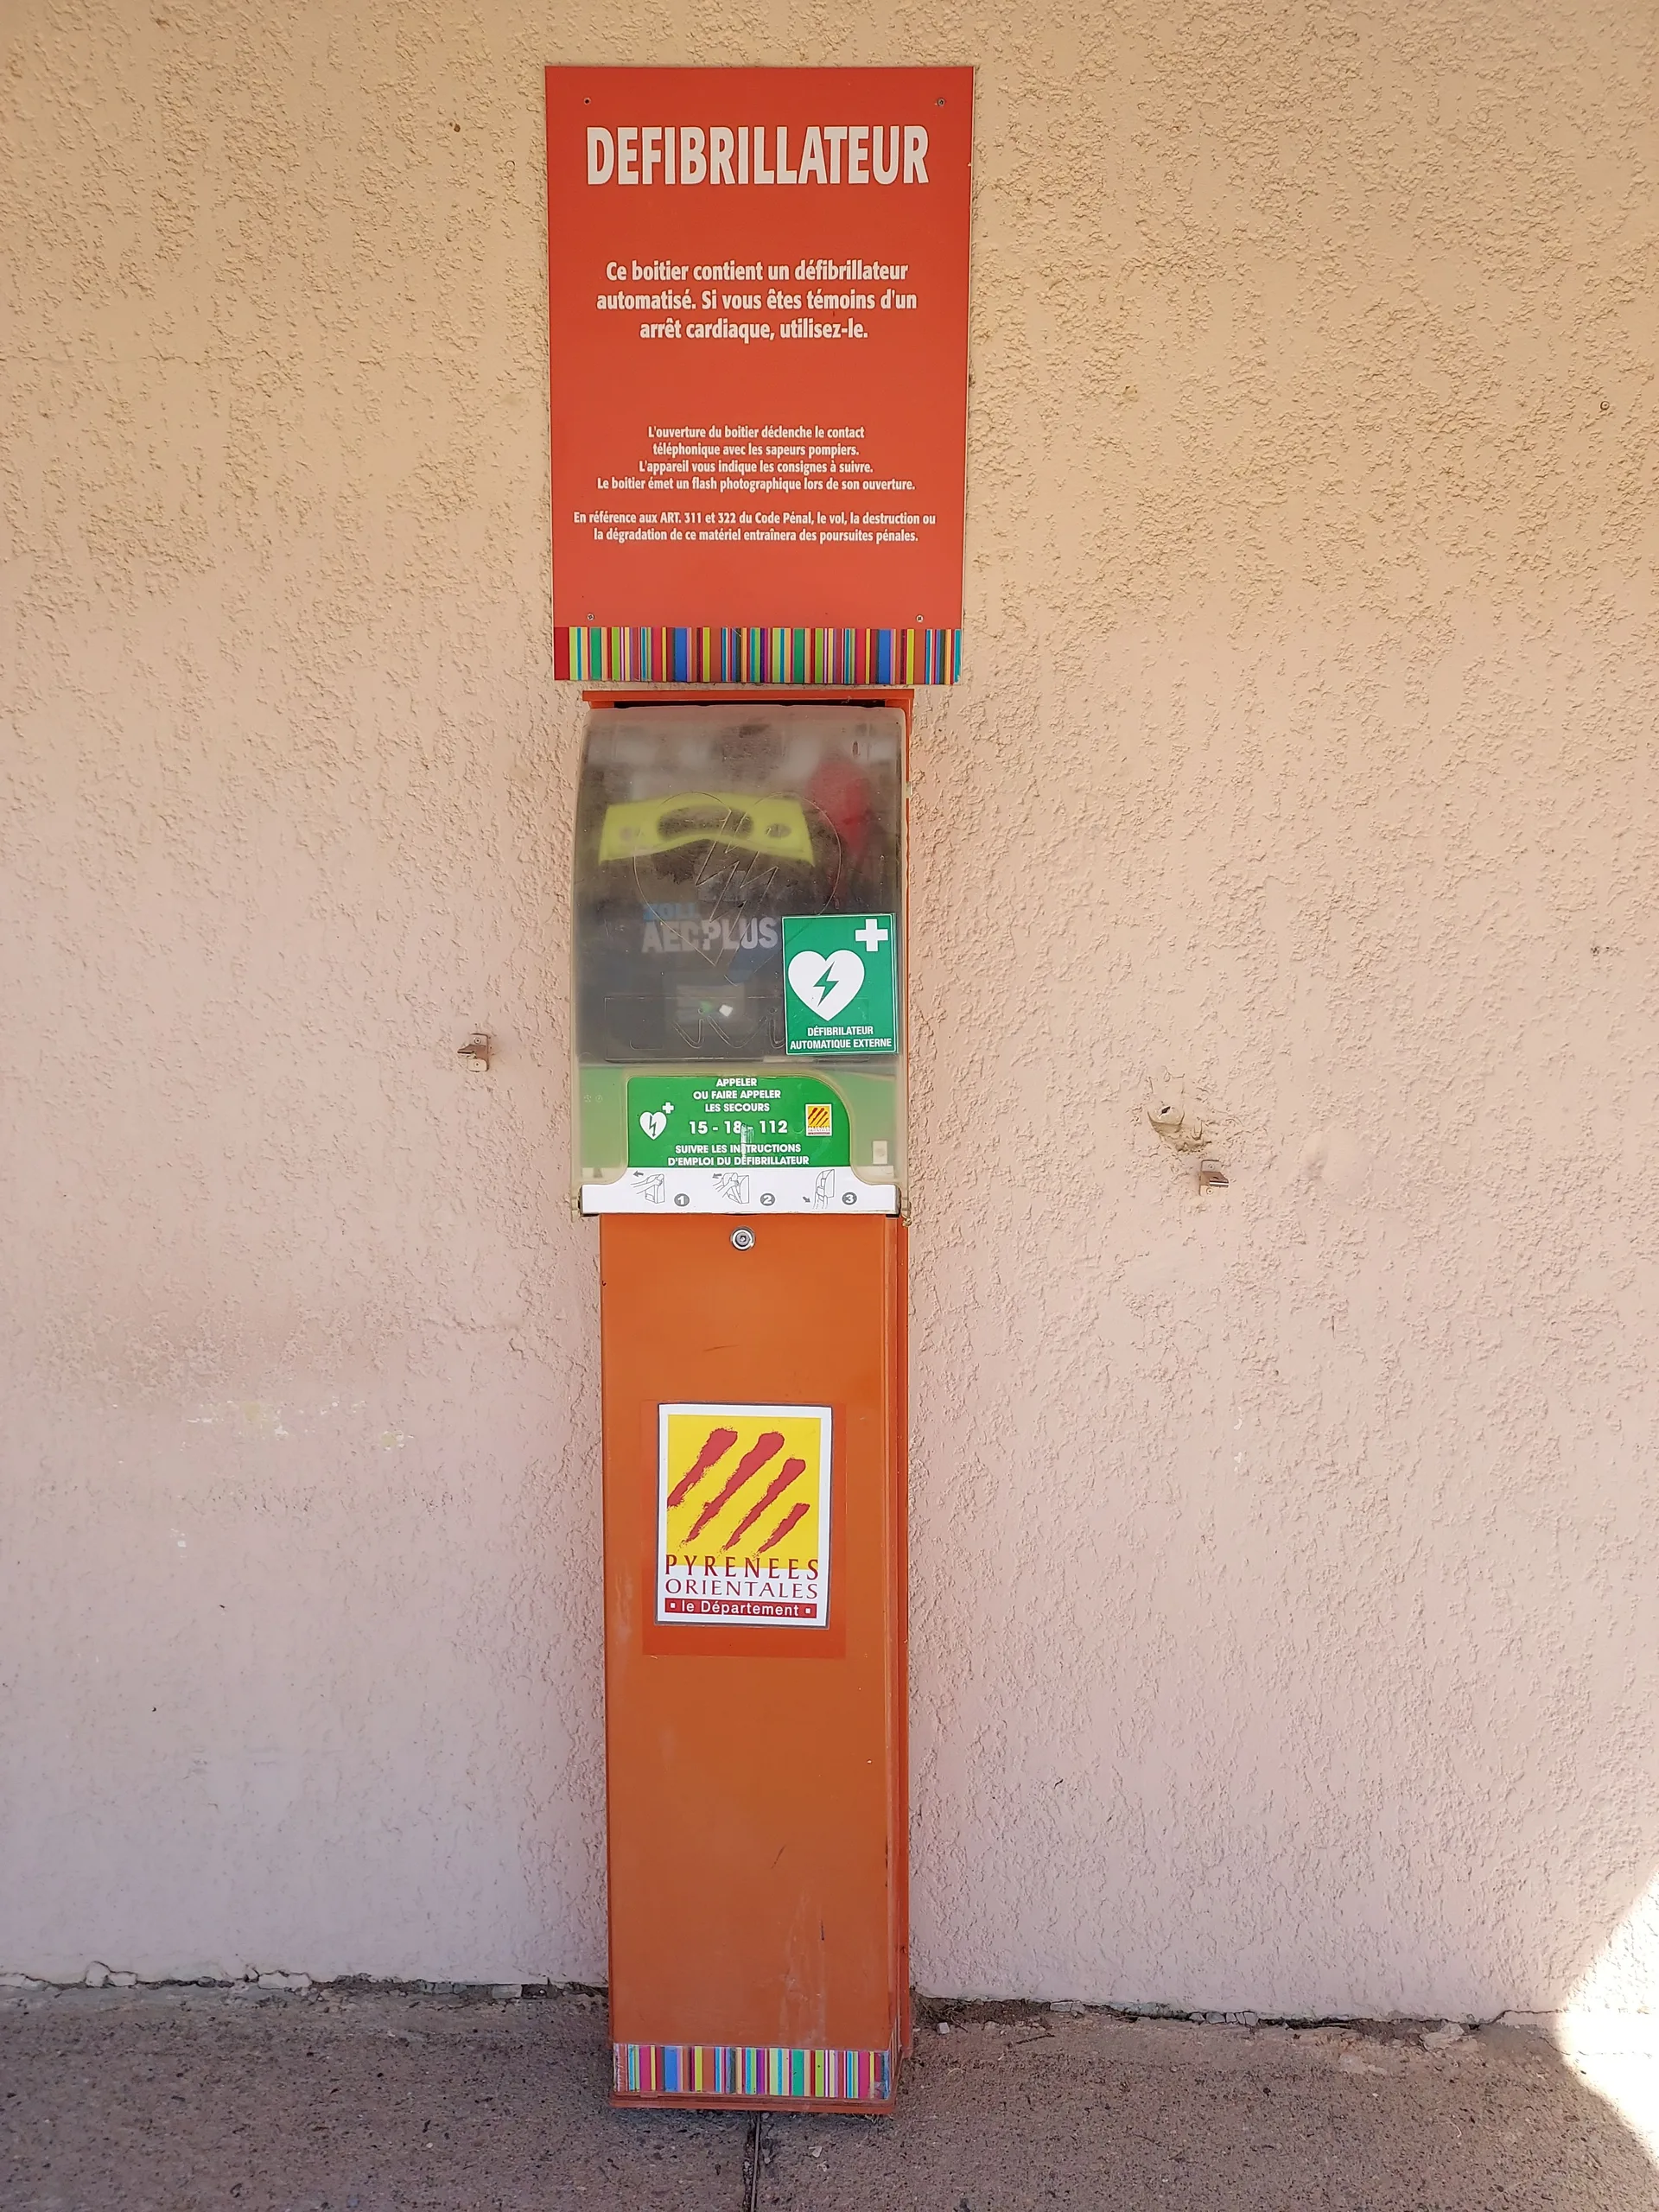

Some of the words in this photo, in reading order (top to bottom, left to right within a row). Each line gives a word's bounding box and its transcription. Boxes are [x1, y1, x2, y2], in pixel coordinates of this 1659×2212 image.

[587, 125, 929, 185] DEFIBRILLATEUR
[606, 261, 627, 281] Ce
[632, 259, 690, 281] boitier
[693, 259, 764, 281] contient
[767, 265, 790, 281] un
[794, 258, 909, 281] défibrillateur
[596, 289, 696, 310] automatisé.
[702, 289, 717, 310] Si
[721, 294, 762, 310] vous
[766, 288, 803, 310] êtes
[806, 288, 875, 309] témoins
[880, 288, 917, 309] d'un
[639, 317, 682, 339] arrêt
[685, 317, 775, 345] cardiaque,
[779, 317, 868, 339] utilisez-le.
[648, 425, 707, 438] L'ouverture
[708, 424, 722, 438] du
[724, 425, 760, 438] boitier
[760, 424, 813, 439] déclenche
[814, 425, 825, 439] le
[826, 426, 865, 439] contact
[652, 442, 721, 459] téléphonique
[722, 445, 747, 455] avec
[747, 442, 763, 455] les
[765, 446, 806, 459] sapeurs
[808, 442, 860, 460] pompiers.
[639, 459, 690, 476] L'appareil
[691, 462, 716, 473] vous
[718, 459, 758, 476] indique
[760, 459, 775, 473] les
[777, 460, 828, 476] consignes
[830, 459, 836, 473] à
[838, 460, 874, 474] suivre.
[597, 477, 609, 489] Le
[611, 476, 646, 490] boitier
[647, 476, 674, 490] émet
[676, 480, 690, 490] un
[691, 476, 717, 490] flash
[720, 476, 802, 493] photographique
[804, 477, 823, 490] lors
[825, 477, 839, 491] de
[841, 480, 861, 490] son
[862, 478, 916, 491] ouverture.
[574, 512, 587, 524] En
[588, 510, 637, 524] référence
[639, 513, 658, 524] aux
[659, 512, 682, 524] ART.
[684, 512, 702, 524] 311
[704, 512, 716, 524] et
[717, 512, 737, 524] 322
[739, 511, 753, 524] du
[754, 511, 781, 524] Code
[782, 511, 815, 525] Pénal,
[817, 511, 827, 524] le
[829, 511, 848, 525] vol,
[849, 512, 860, 524] la
[861, 511, 920, 524] destruction
[922, 515, 936, 525] ou
[594, 527, 604, 540] la
[606, 527, 668, 543] dégradation
[670, 527, 683, 541] de
[684, 531, 696, 541] ce
[698, 527, 741, 541] matériel
[743, 528, 797, 541] entraînera
[798, 528, 817, 542] des
[819, 528, 874, 545] poursuites
[875, 528, 918, 545] pénales.
[807, 1025, 874, 1037] DÉFIBRILATEUR
[790, 1039, 852, 1050] AUTOMATIQUE
[853, 1038, 893, 1048] EXTERNE
[715, 1077, 758, 1088] APPELER
[692, 1090, 709, 1100] OU
[711, 1090, 738, 1100] FAIRE
[739, 1090, 781, 1099] APPELER
[704, 1103, 721, 1113] LES
[723, 1103, 770, 1112] SECOURS
[689, 1121, 709, 1135] 15
[723, 1120, 741, 1135] 18
[760, 1120, 788, 1135] 112
[675, 1144, 709, 1154] SUIVRE
[711, 1144, 728, 1154] LES
[667, 1156, 715, 1166] D'EMPLOI
[716, 1156, 732, 1166] DU
[734, 1155, 810, 1166] DÉFIBRILLATEUR
[665, 1554, 819, 1580] PYRENEES
[664, 1578, 818, 1599] ORIENTALES
[681, 1599, 695, 1612] le
[700, 1599, 799, 1617] Département
